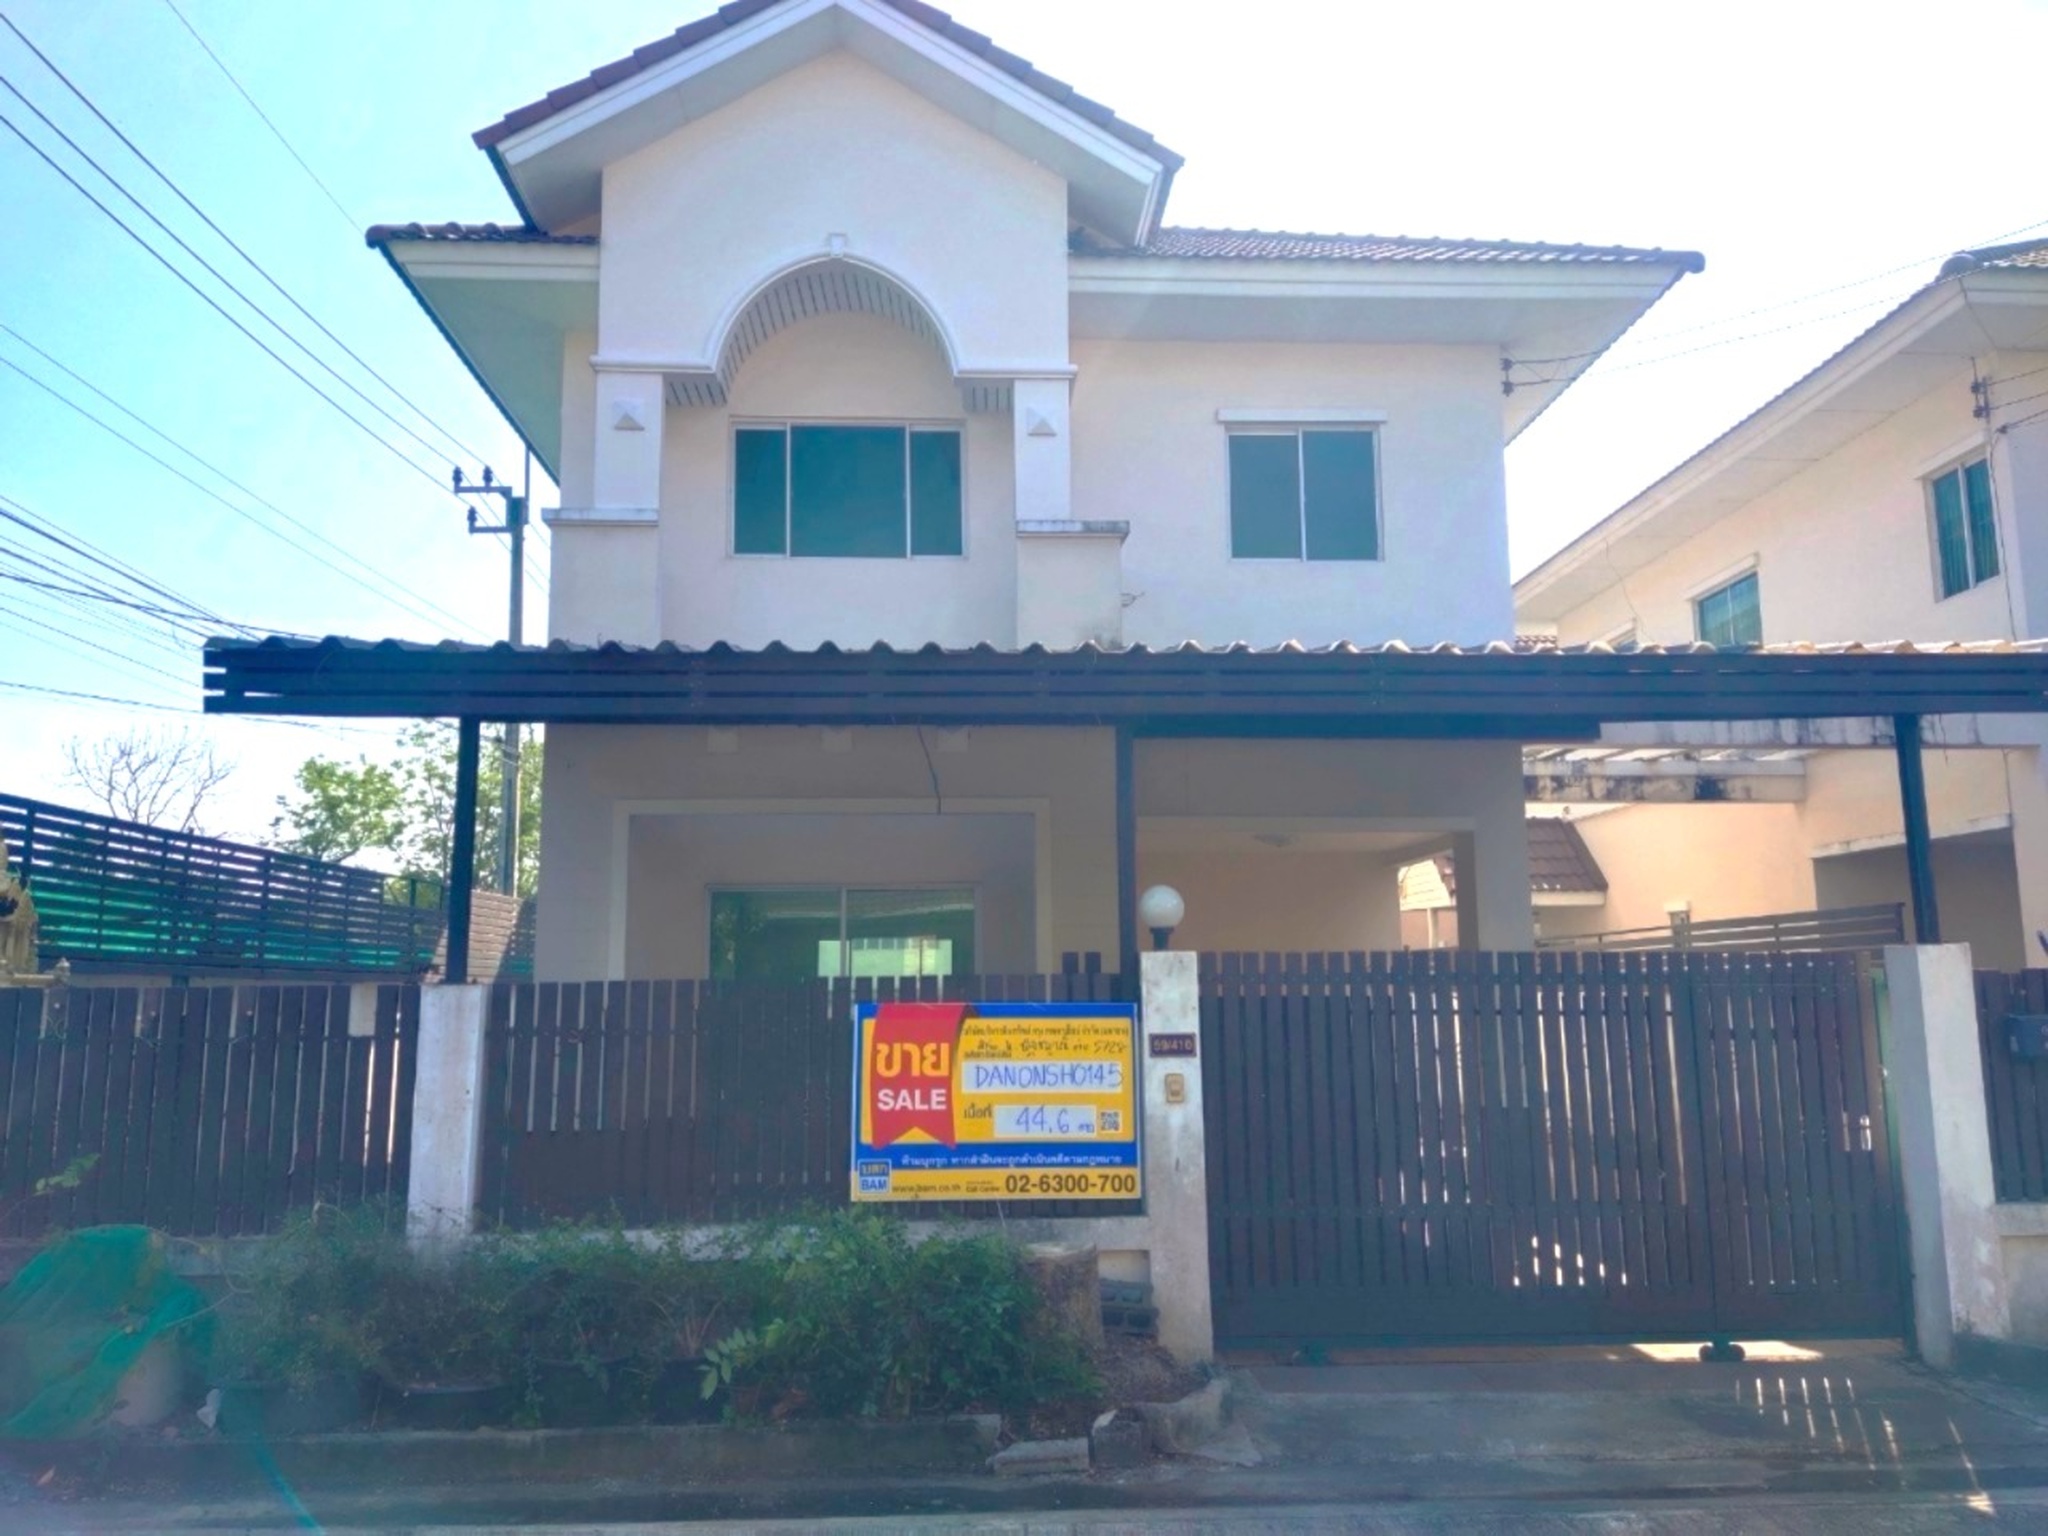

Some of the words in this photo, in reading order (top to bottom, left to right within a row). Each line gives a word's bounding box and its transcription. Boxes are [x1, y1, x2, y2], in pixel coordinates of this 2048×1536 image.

[876, 1042, 950, 1077] ขาย
[877, 1088, 947, 1111] SALE
[861, 1179, 887, 1191] BAM
[1005, 1174, 1136, 1193] 02-6300-700
